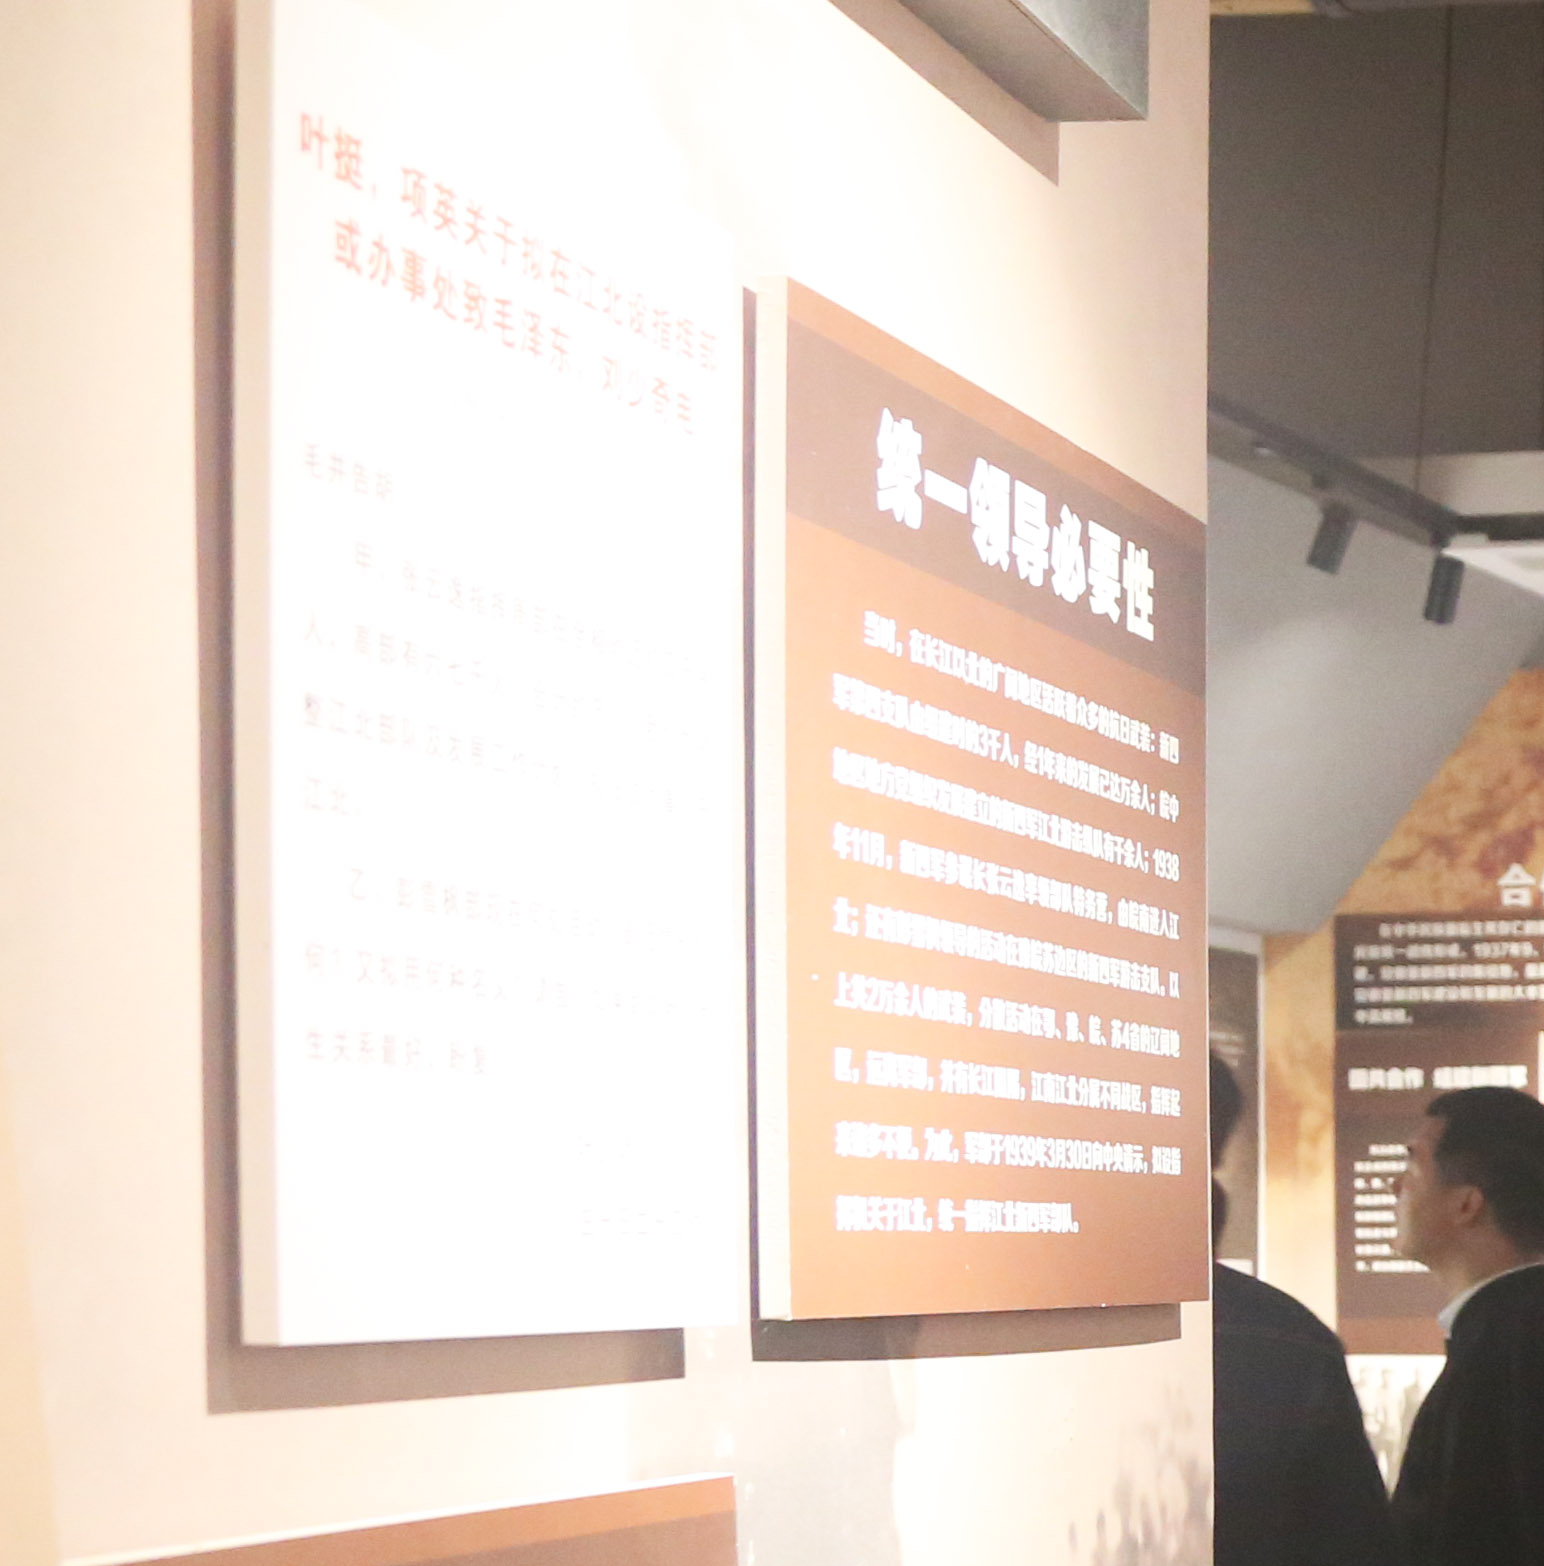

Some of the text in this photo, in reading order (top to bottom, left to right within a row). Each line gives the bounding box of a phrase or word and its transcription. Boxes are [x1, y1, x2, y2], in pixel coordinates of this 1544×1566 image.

[876, 407, 1155, 641] 统一领导必要性
